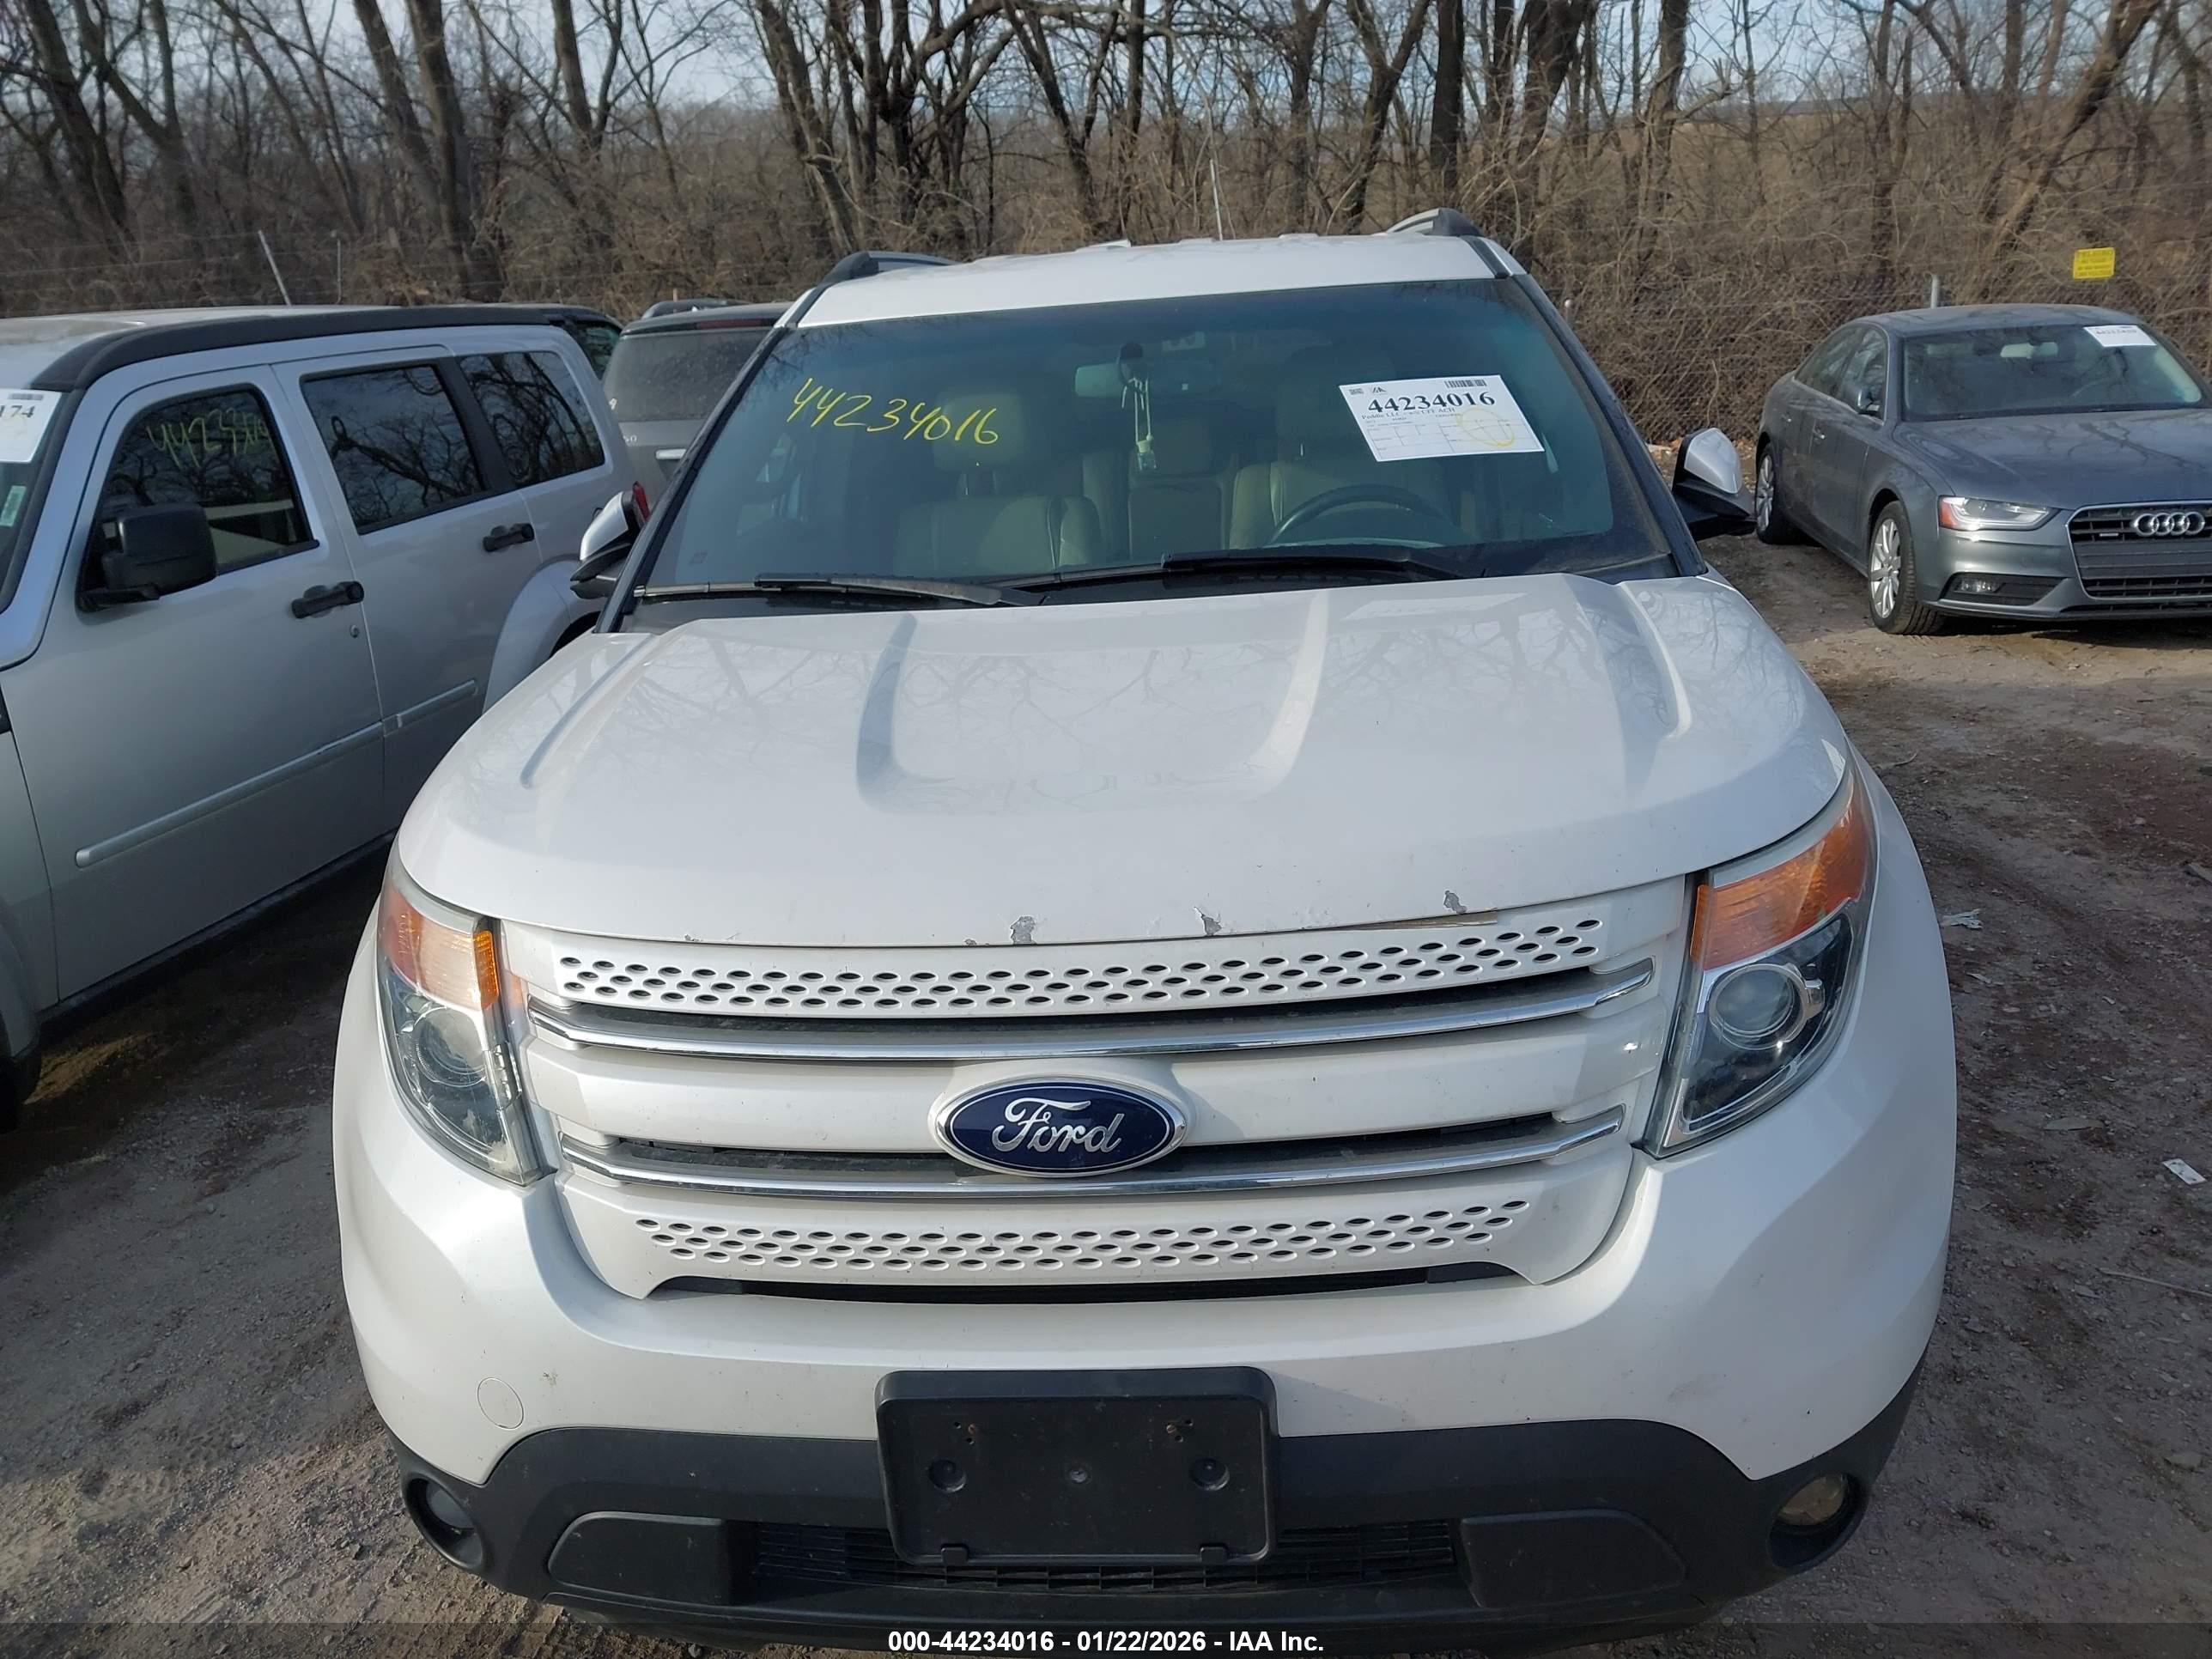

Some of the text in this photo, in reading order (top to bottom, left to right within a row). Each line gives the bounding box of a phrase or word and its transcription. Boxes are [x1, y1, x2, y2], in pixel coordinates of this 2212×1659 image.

[787, 378, 999, 445] 44234016
[1368, 391, 1496, 413] 44234016
[991, 1097, 1125, 1152] Ford
